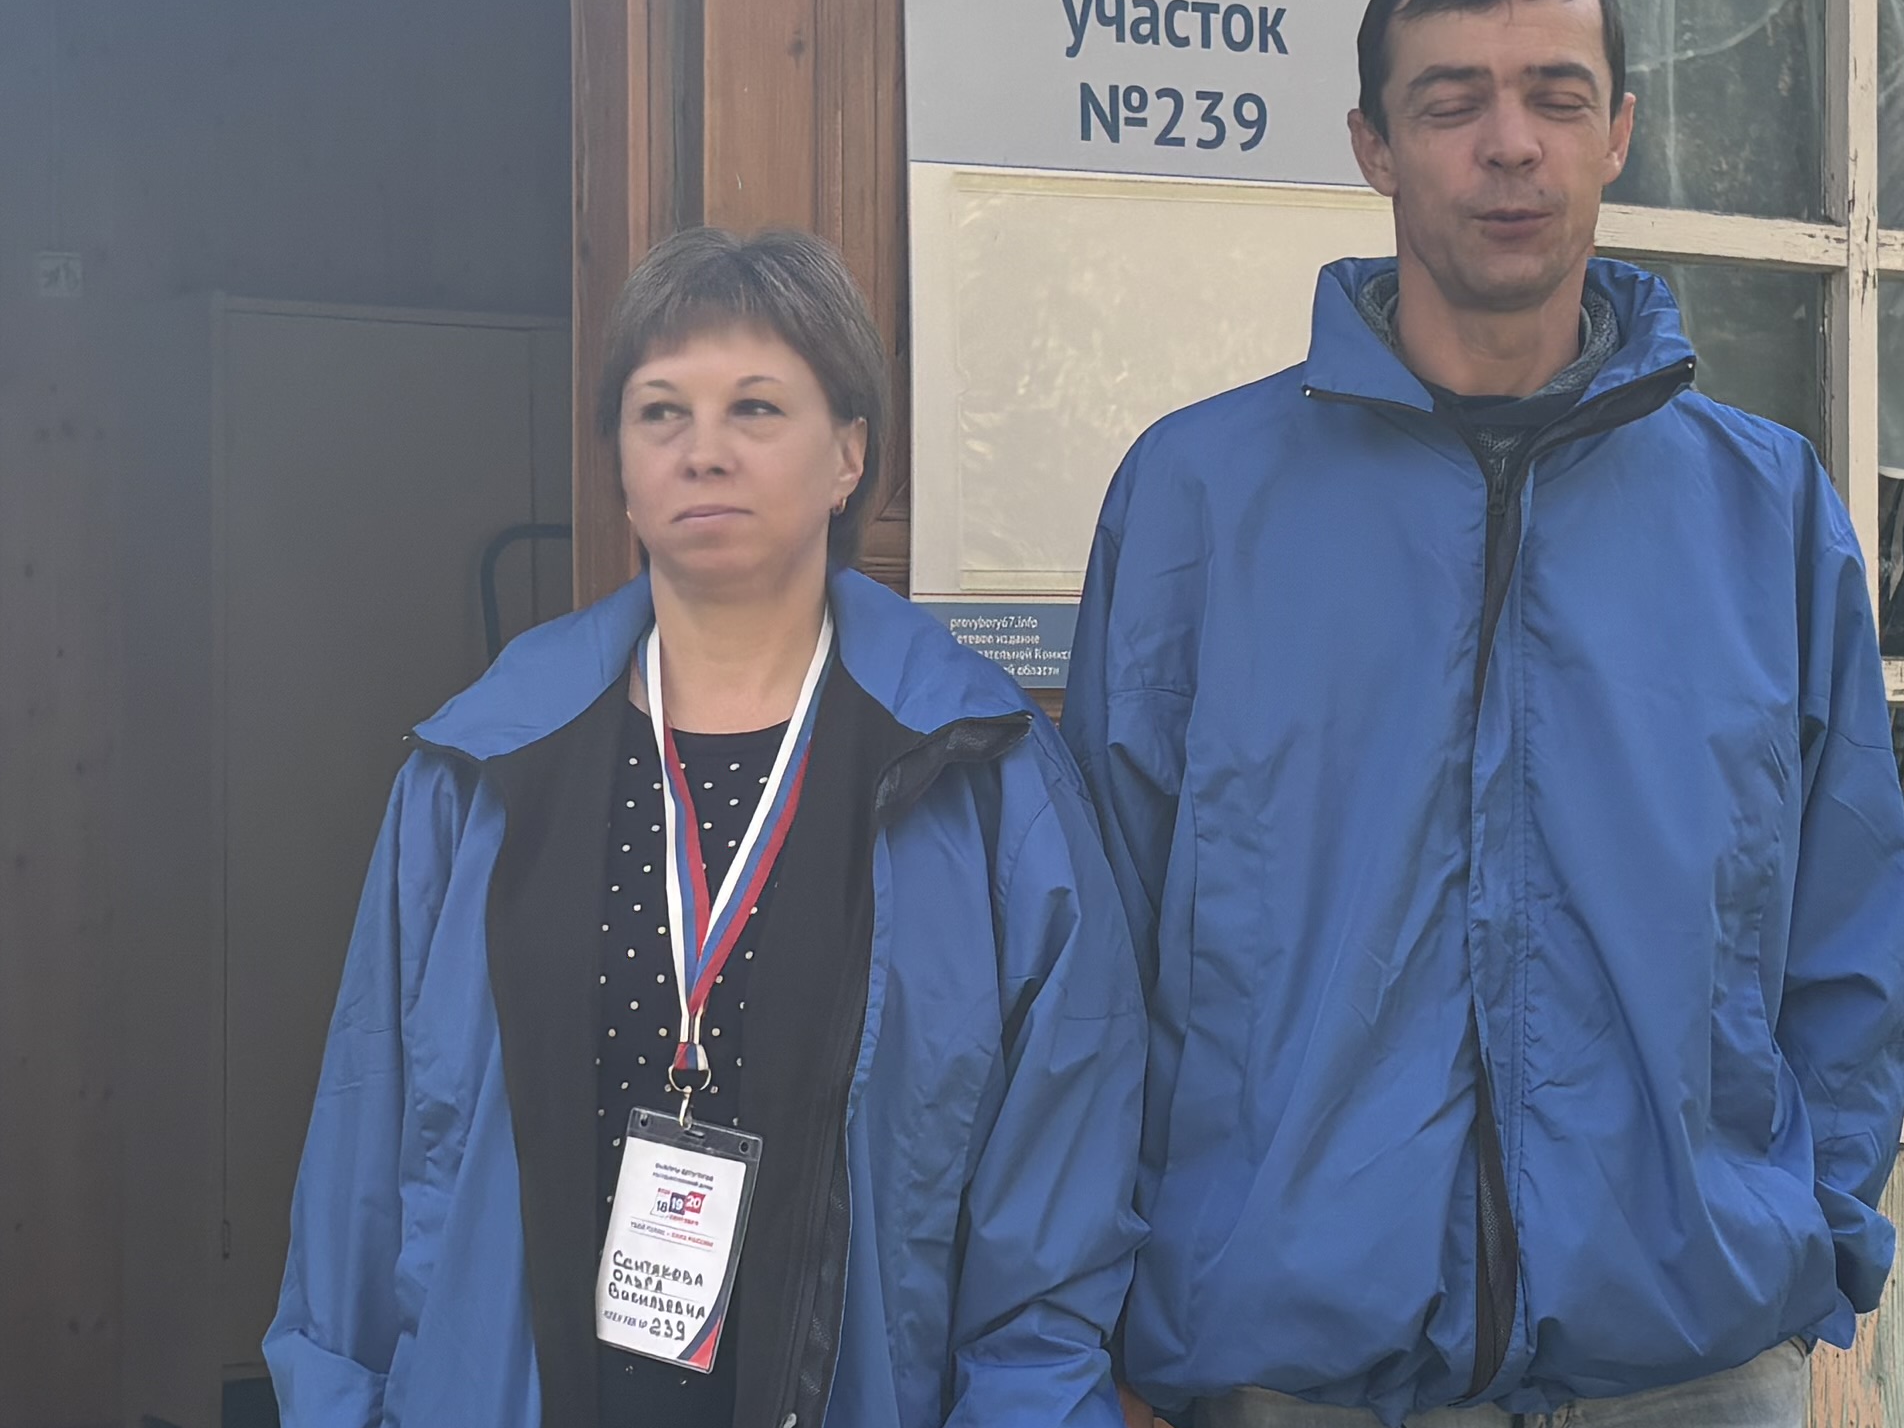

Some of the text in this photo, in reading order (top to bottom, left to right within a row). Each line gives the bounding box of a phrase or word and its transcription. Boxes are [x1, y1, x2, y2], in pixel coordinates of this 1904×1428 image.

[1079, 82, 1268, 152] №239
[656, 1196, 701, 1212] 18 19 20
